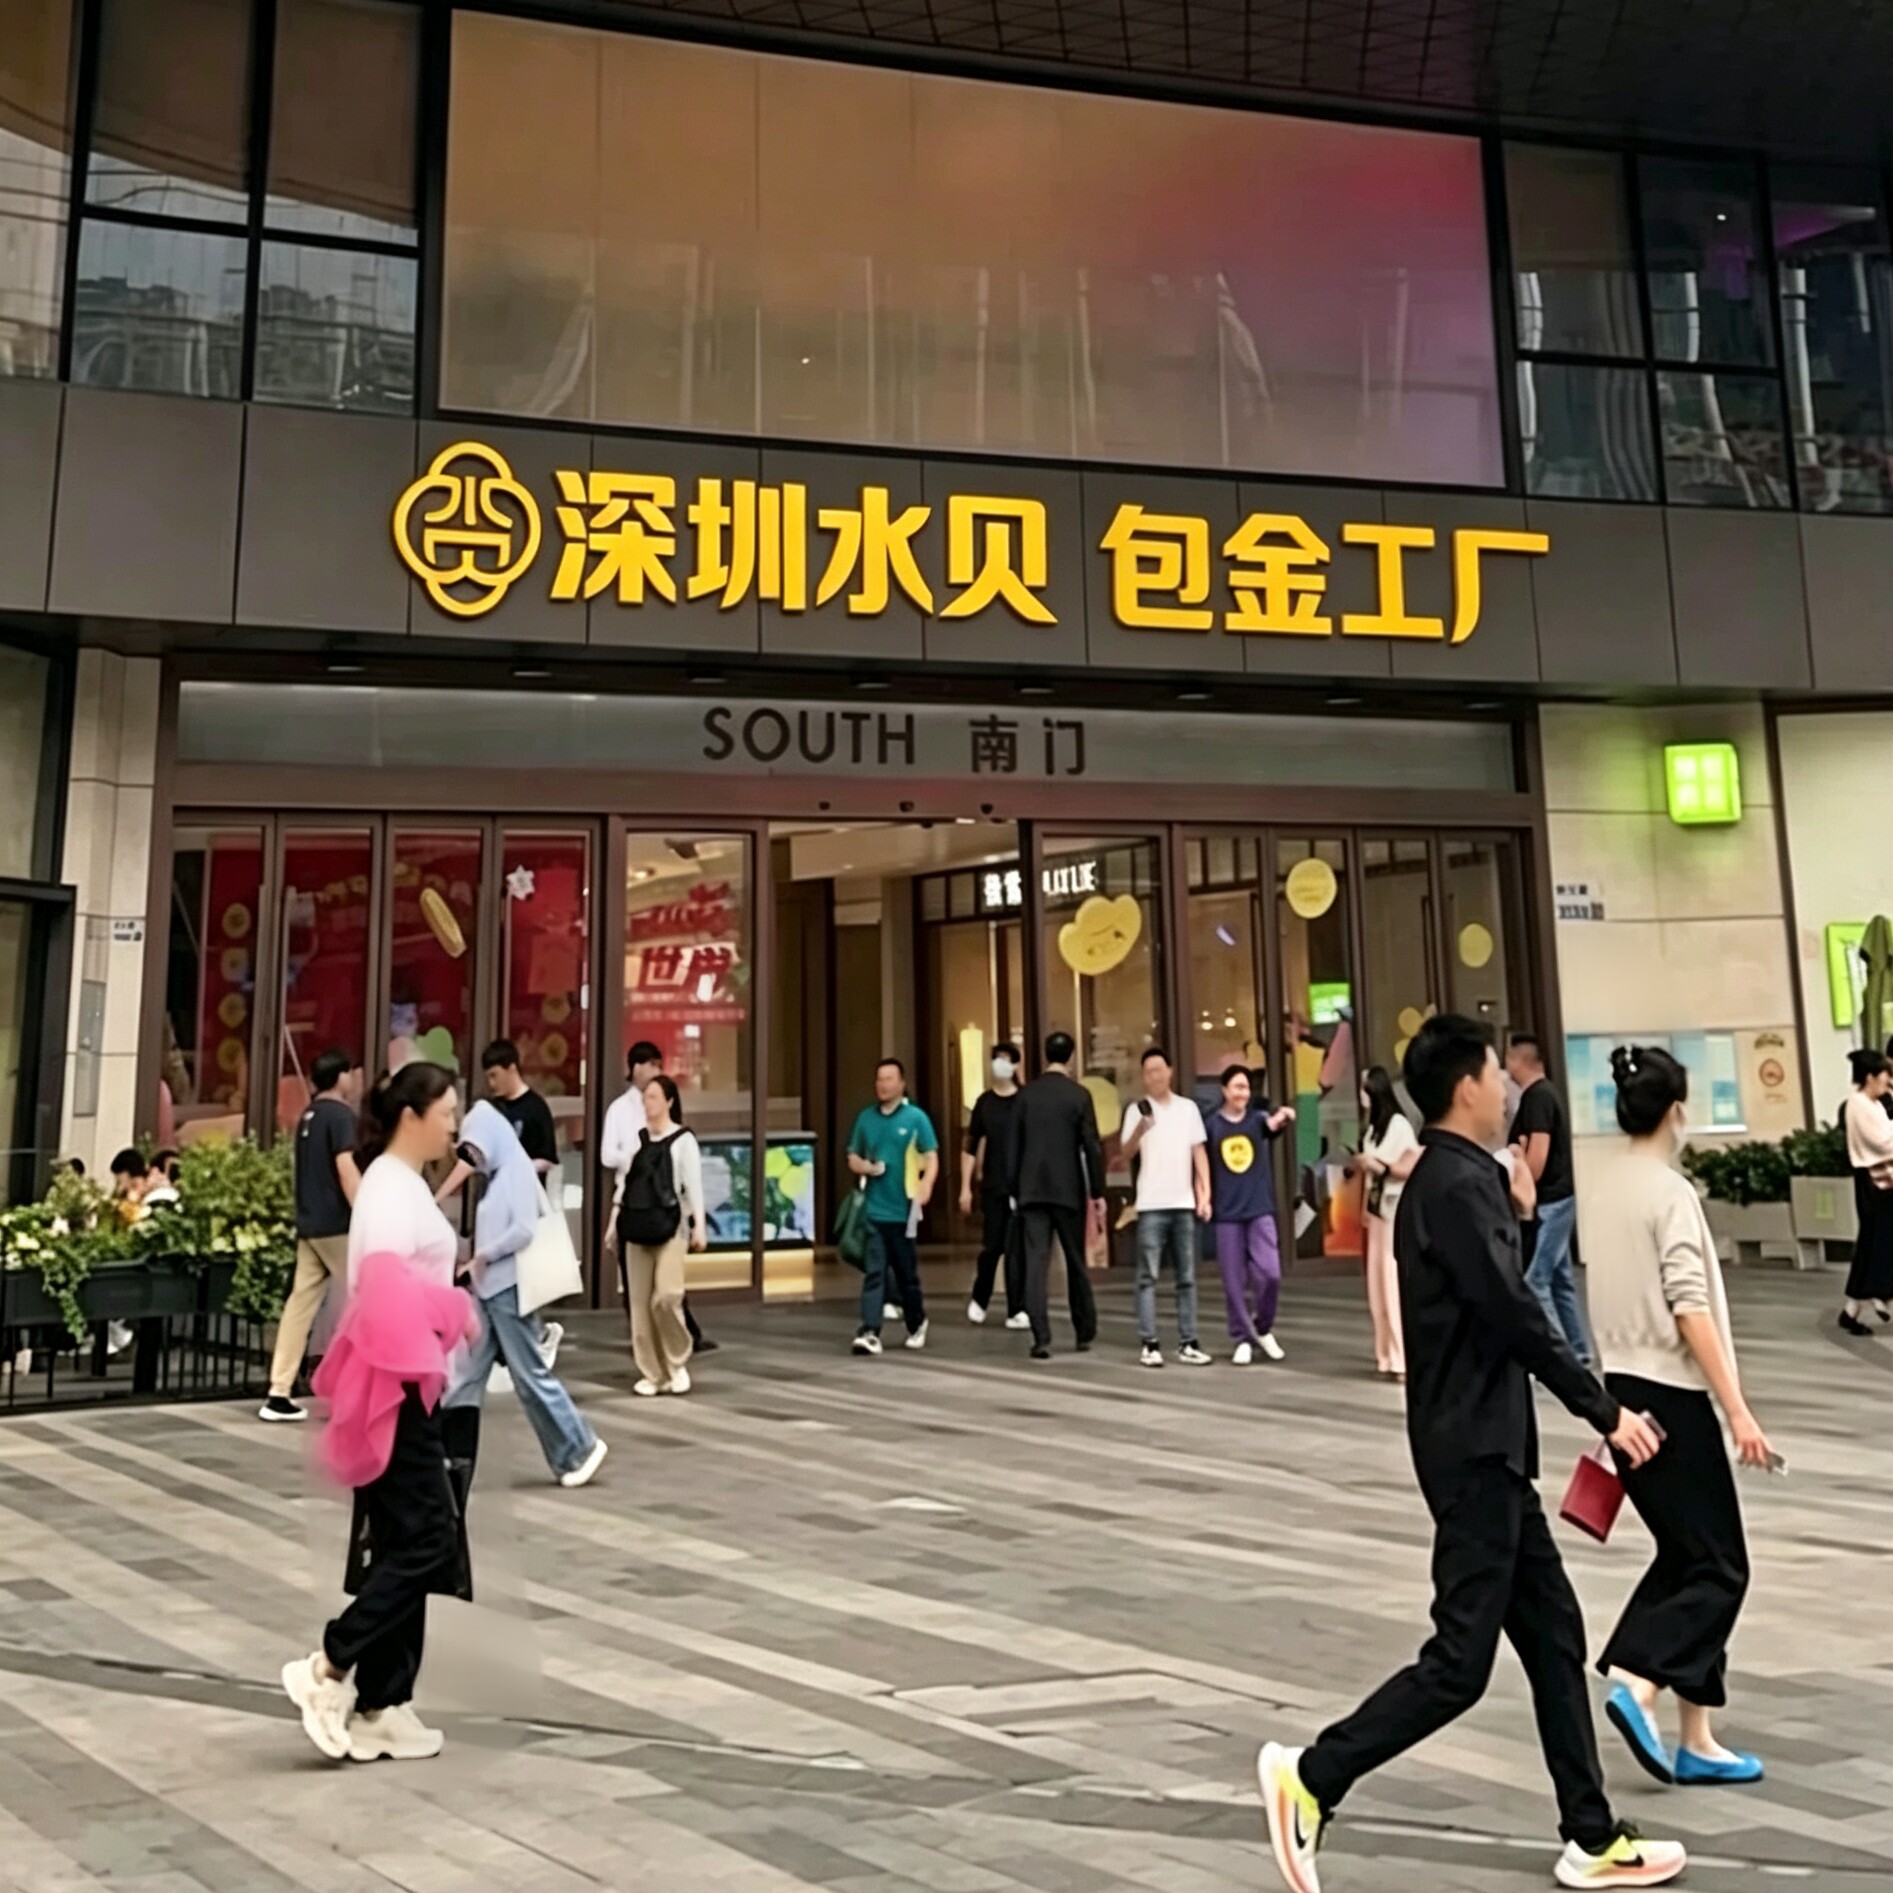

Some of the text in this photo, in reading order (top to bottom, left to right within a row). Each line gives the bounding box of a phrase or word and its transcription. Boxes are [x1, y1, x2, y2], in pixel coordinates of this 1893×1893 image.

[549, 469, 1549, 644] 深圳水贝 包金工厂
[702, 706, 915, 765] SOUTH
[968, 713, 1086, 776] 南门
